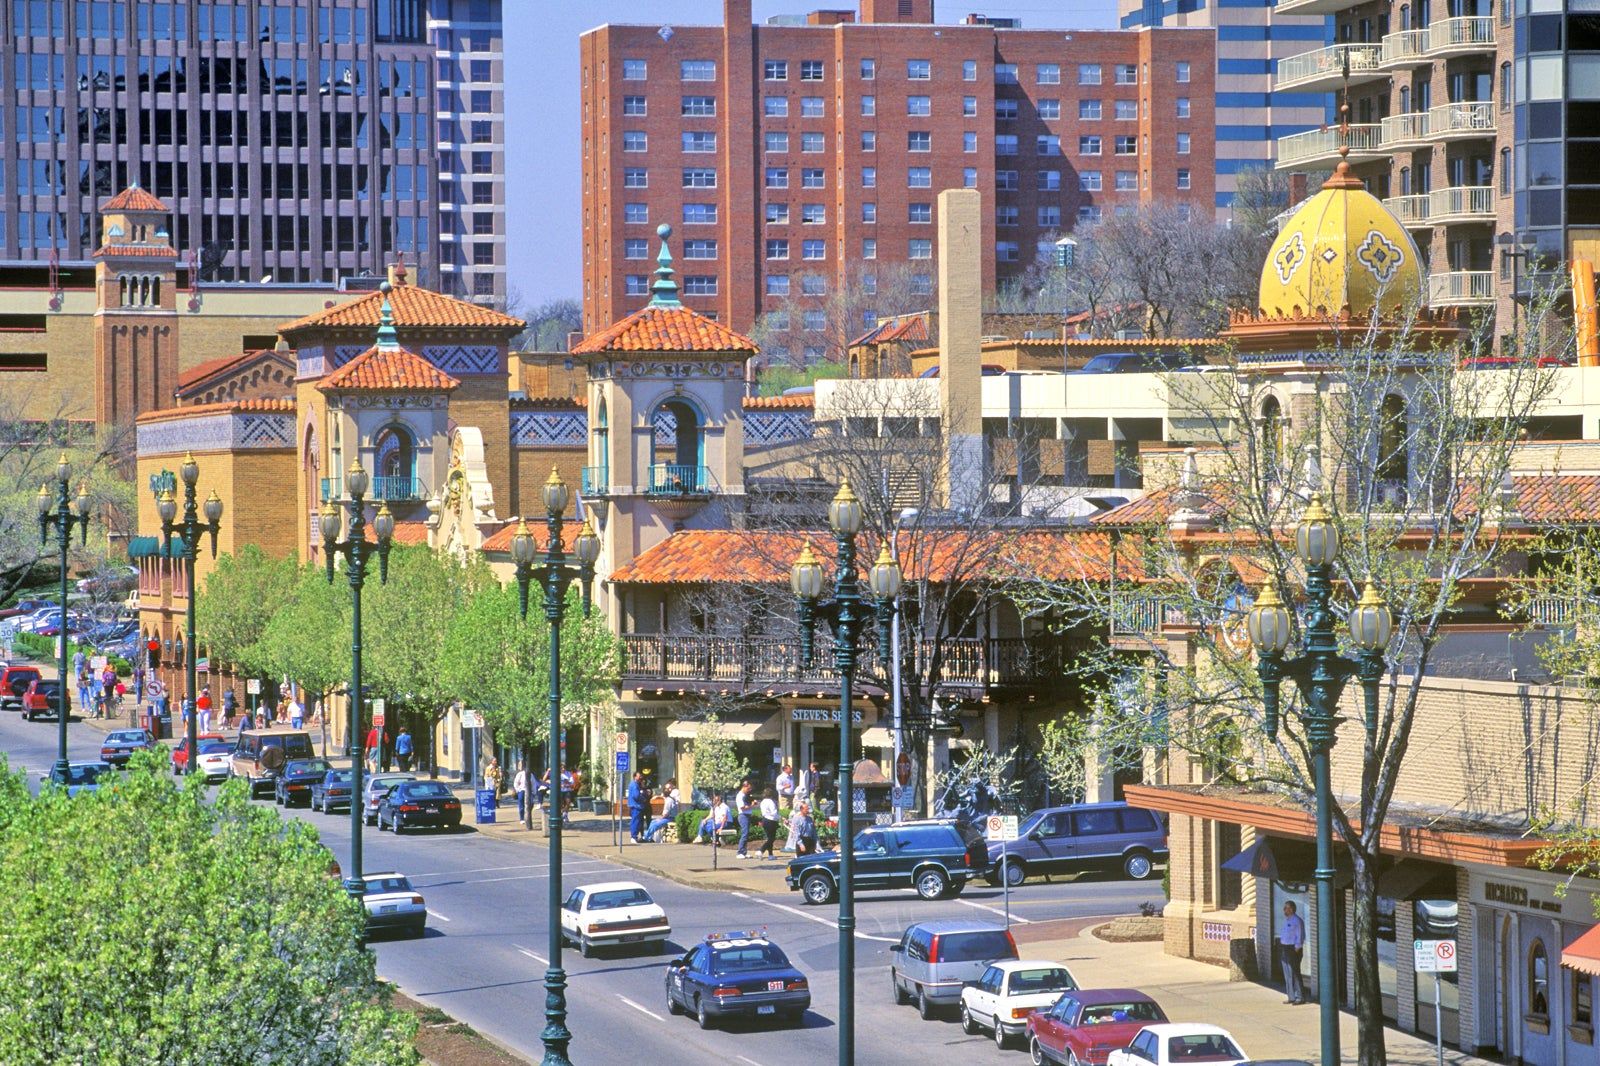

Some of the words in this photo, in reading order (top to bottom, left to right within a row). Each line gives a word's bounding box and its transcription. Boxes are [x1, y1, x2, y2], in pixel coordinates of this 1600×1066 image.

[792, 709, 829, 720] STEVE'S
[831, 710, 862, 722] SES
[1485, 881, 1528, 908] MICHAEL'S
[769, 981, 783, 991] 911
